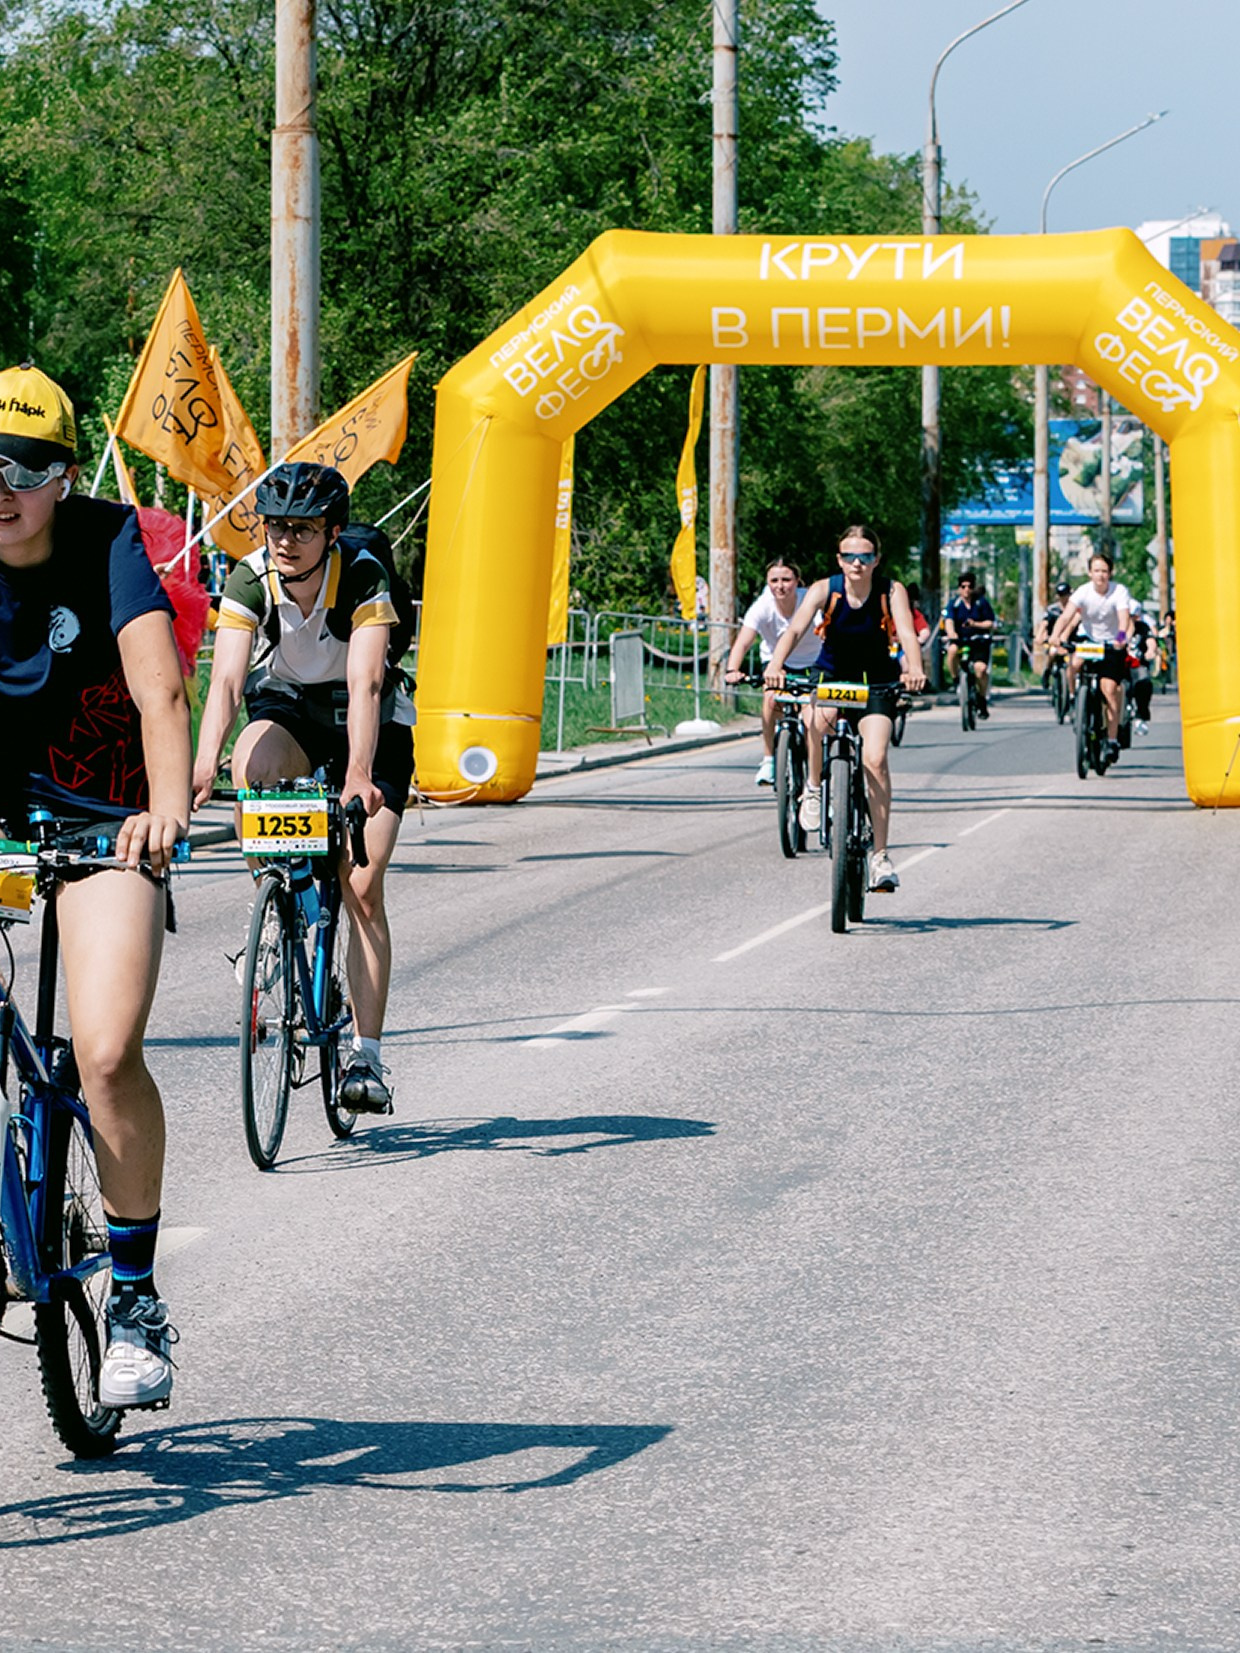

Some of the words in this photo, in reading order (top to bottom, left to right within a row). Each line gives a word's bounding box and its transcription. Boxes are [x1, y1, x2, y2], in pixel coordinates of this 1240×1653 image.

[760, 242, 965, 280] КРУТИ
[489, 284, 581, 368] ПЕРМСКИЙ
[711, 306, 749, 349] В
[771, 305, 1010, 349] ПЕРМИ!
[1143, 281, 1240, 363] ПЕРМСКИЙ
[175, 318, 221, 400] ПЕРМС
[827, 688, 858, 701] 1241
[257, 816, 313, 836] 1253
